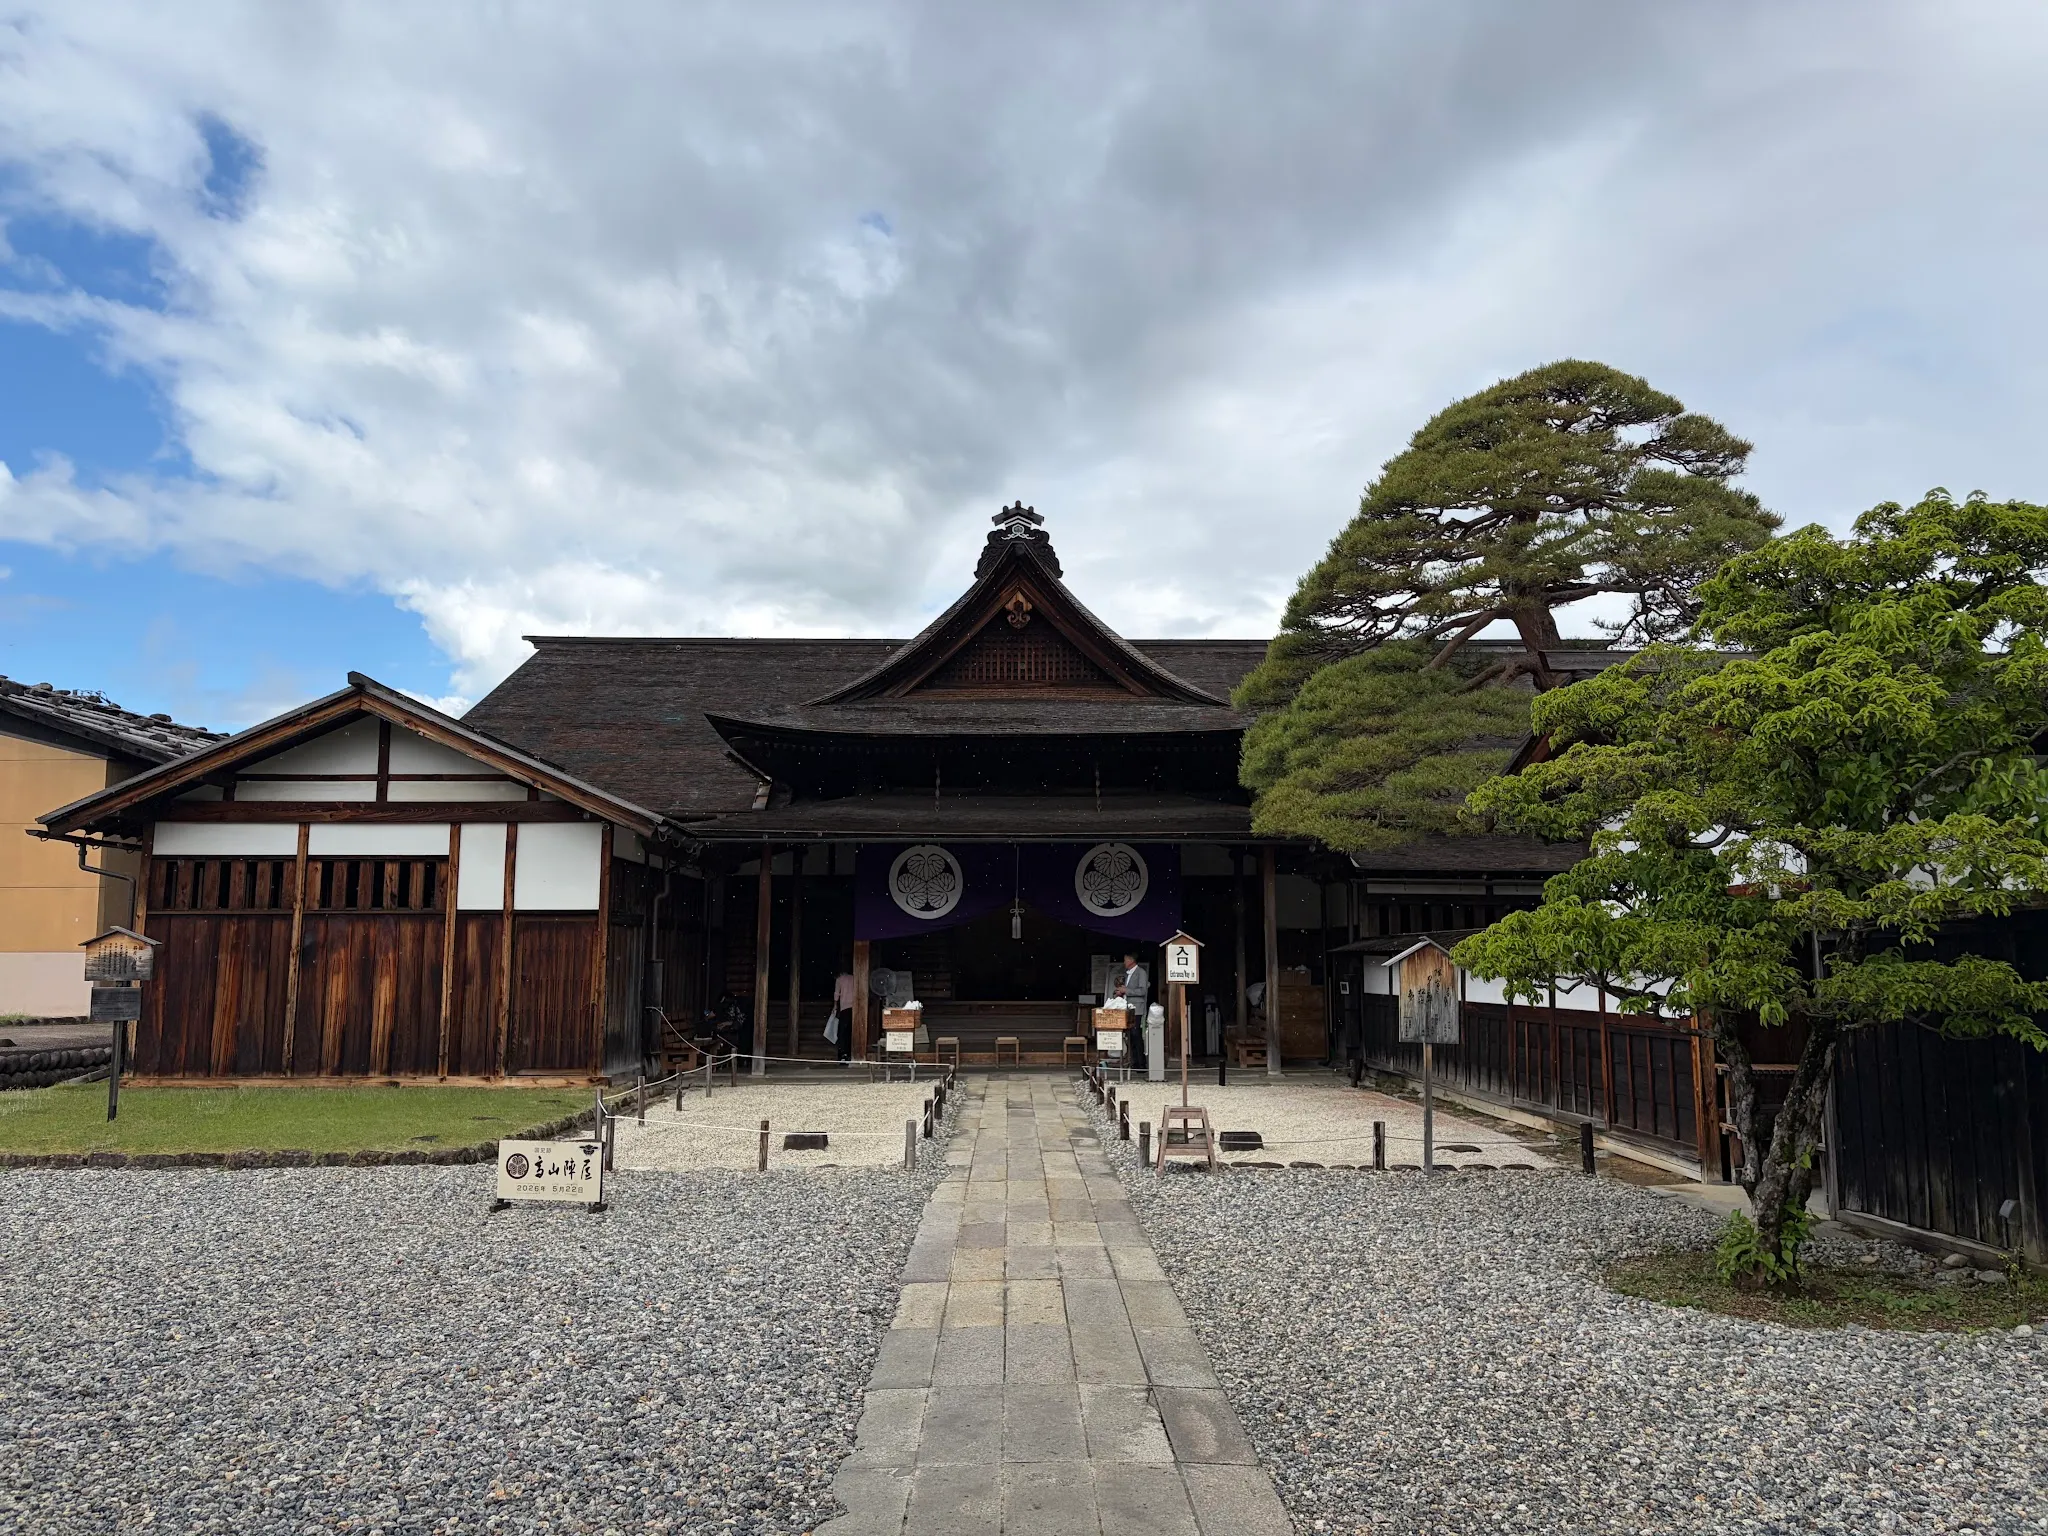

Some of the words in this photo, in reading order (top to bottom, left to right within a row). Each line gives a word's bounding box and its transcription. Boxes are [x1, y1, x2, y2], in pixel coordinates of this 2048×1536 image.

[1176, 946, 1189, 966] 入口
[534, 1156, 593, 1180] 高山陣屋
